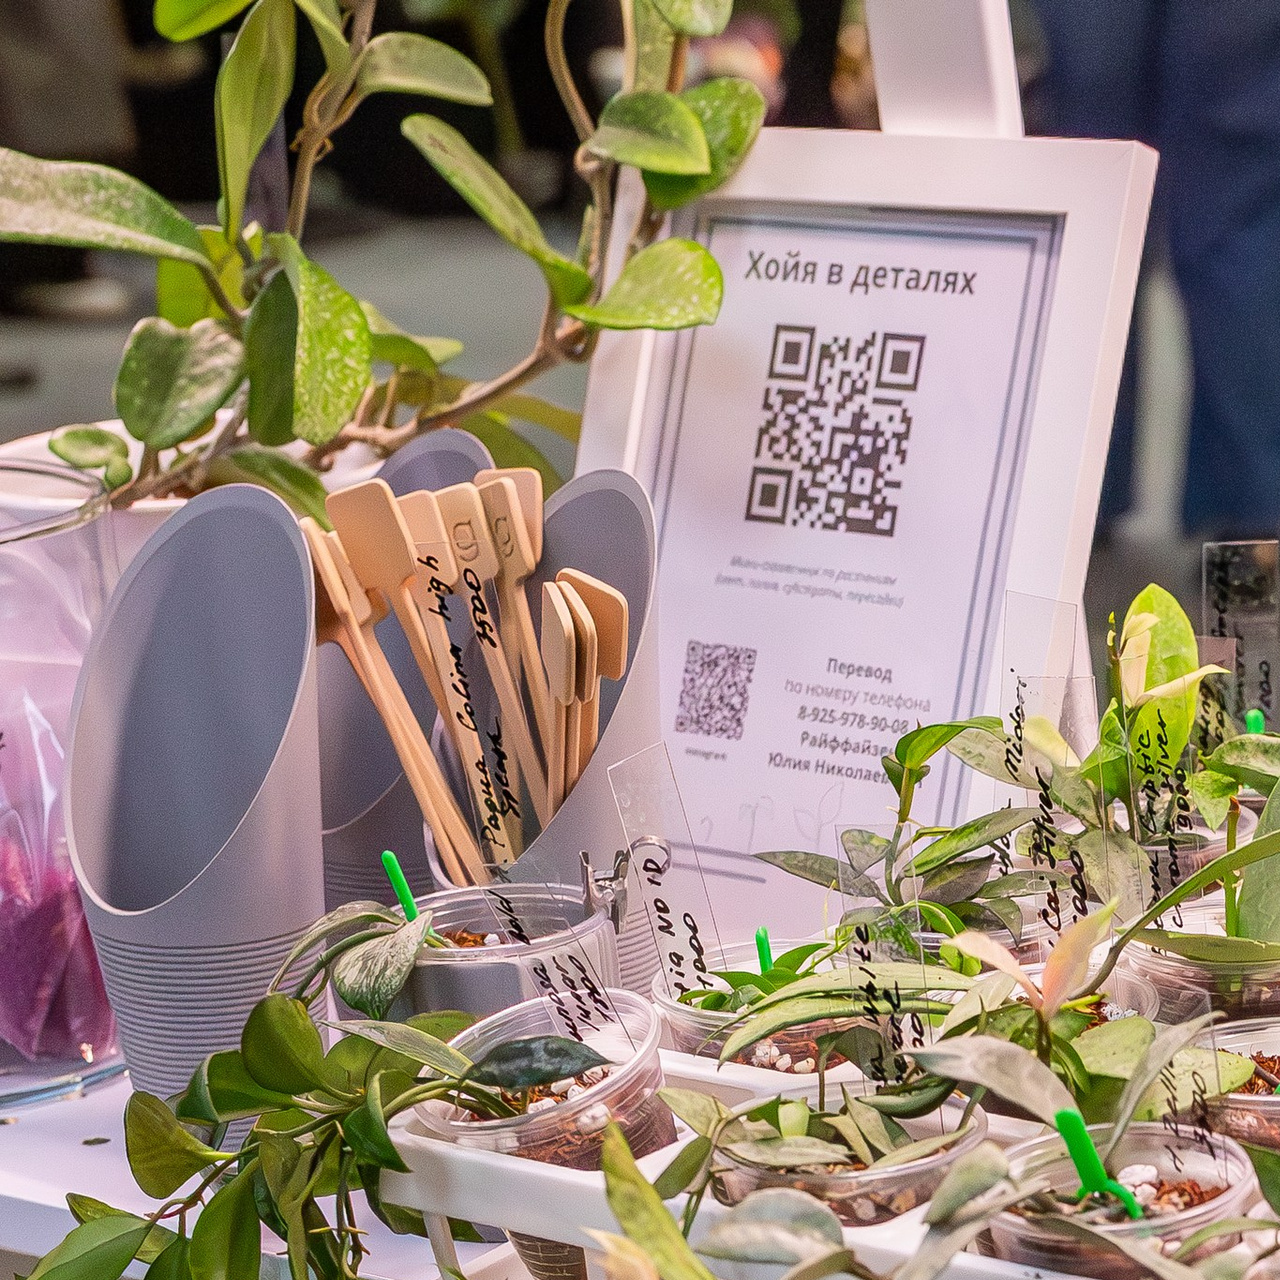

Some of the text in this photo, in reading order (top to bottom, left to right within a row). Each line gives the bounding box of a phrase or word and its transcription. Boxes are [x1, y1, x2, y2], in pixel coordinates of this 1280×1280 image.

[745, 250, 977, 295] Хойя в деталях
[463, 567, 497, 649] 3500
[827, 657, 893, 683] Перевод
[784, 679, 932, 713] по номеру телефона
[797, 705, 909, 735] 8-925-978-90-08
[800, 731, 895, 758] Райффайзе
[768, 752, 811, 773] Юлия
